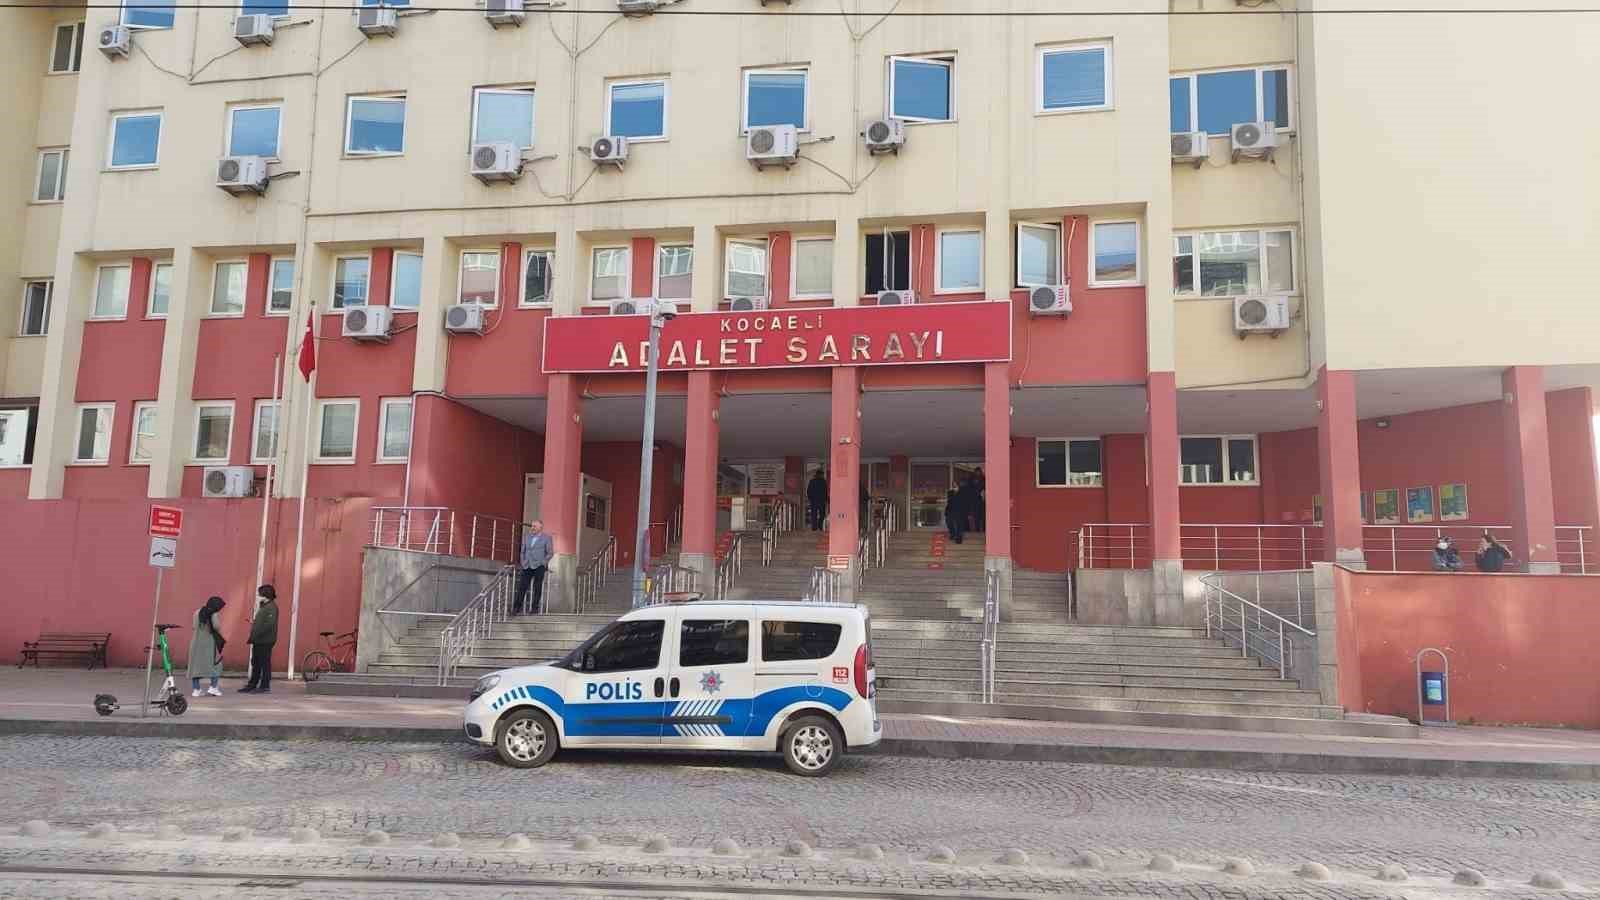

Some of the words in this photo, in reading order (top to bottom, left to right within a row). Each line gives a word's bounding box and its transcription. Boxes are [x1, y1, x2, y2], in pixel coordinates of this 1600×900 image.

[786, 330, 944, 363] SARAYI
[835, 669, 848, 677] 112
[586, 677, 642, 700] POLİS
